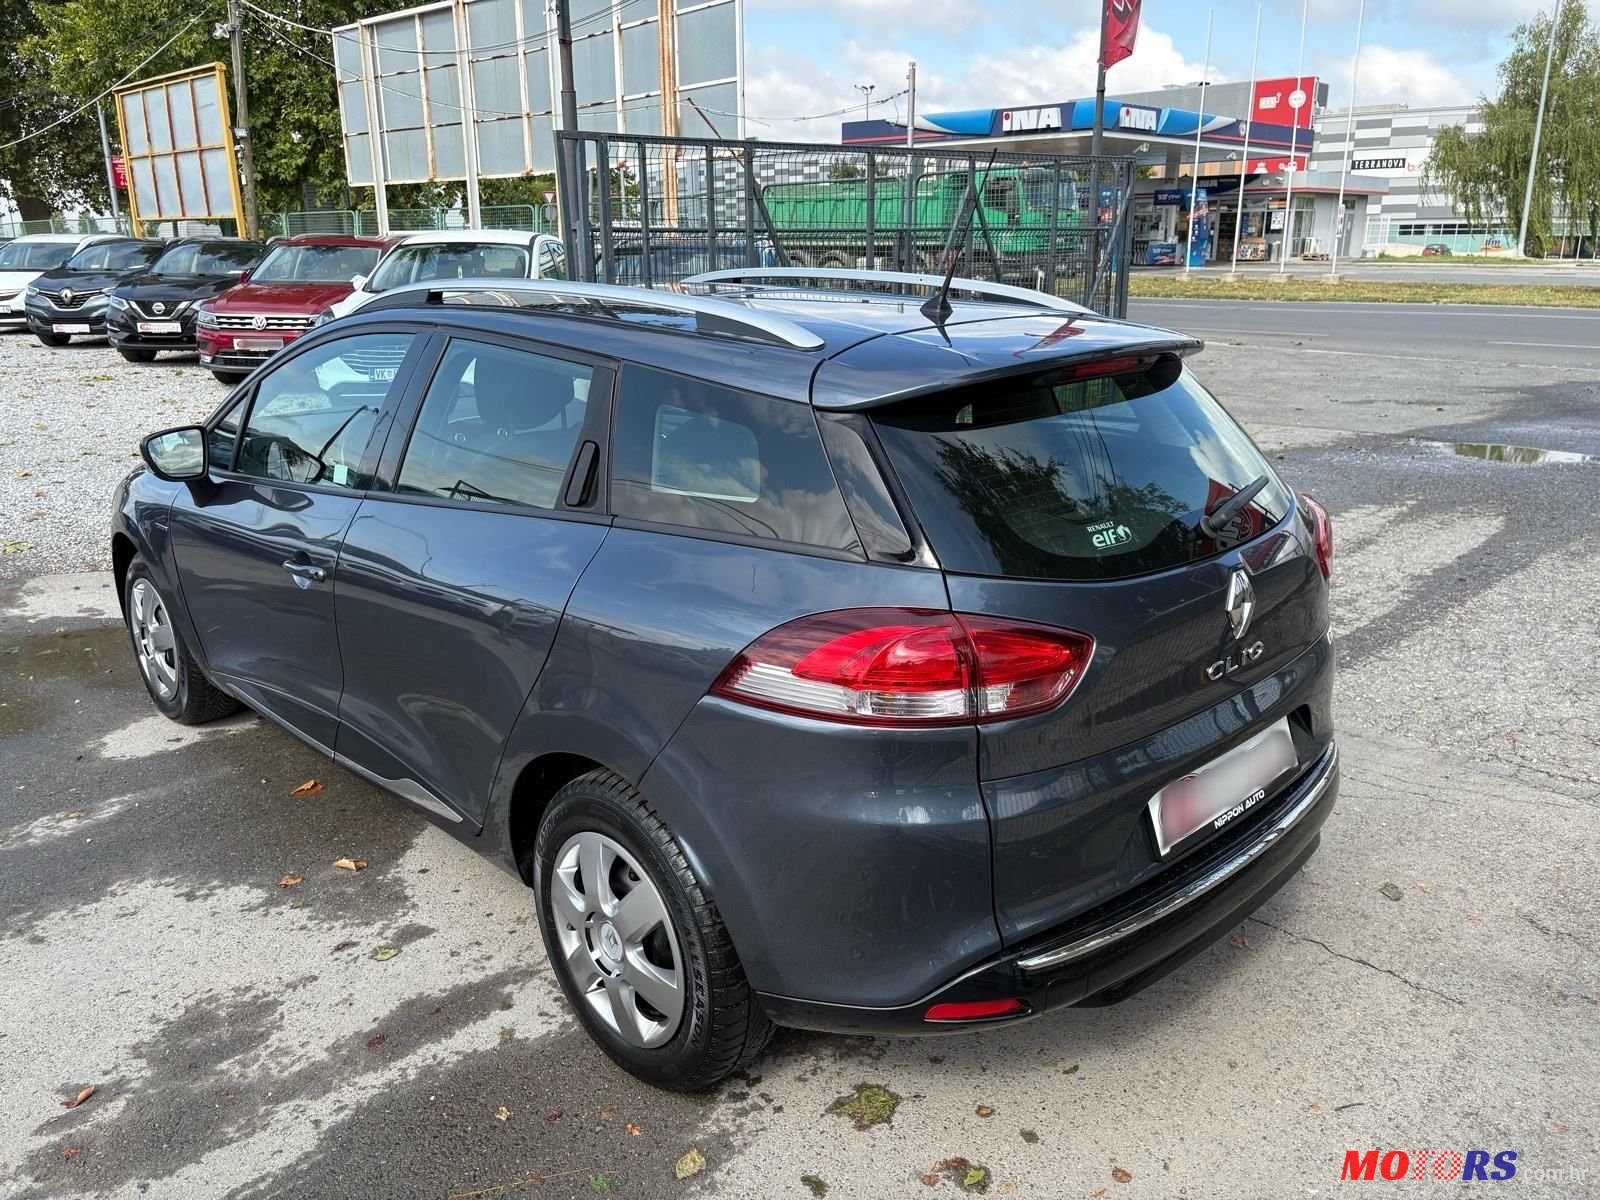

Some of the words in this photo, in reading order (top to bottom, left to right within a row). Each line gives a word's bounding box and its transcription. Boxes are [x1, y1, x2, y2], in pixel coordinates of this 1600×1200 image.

[1002, 107, 1062, 132] INA
[1355, 159, 1403, 169] TERRANOVA
[1086, 521, 1115, 533] RENAULT
[1092, 528, 1117, 547] elf
[1206, 640, 1265, 681] CLIO
[1213, 803, 1245, 829] NIPPON
[1245, 789, 1265, 810] AUTO
